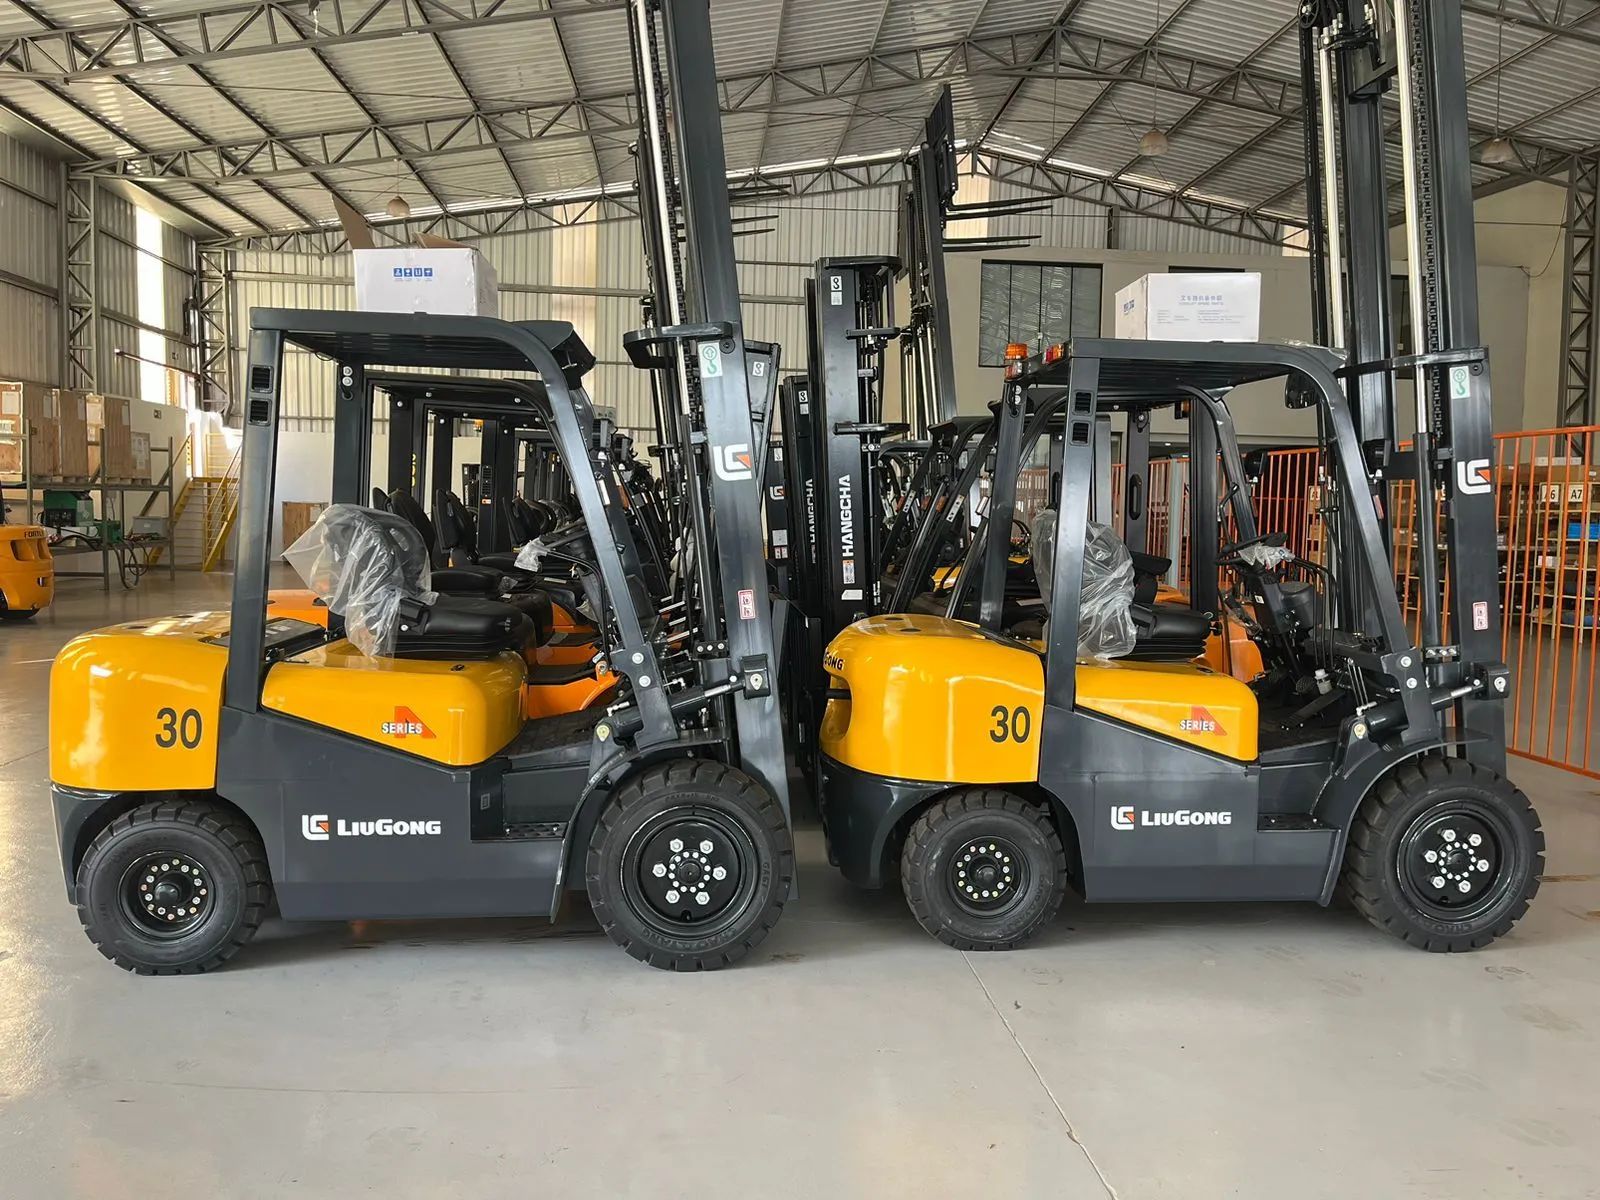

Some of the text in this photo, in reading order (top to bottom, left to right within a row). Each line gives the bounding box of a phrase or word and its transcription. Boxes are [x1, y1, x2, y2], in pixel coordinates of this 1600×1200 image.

[1570, 488, 1583, 500] A7
[838, 474, 855, 557] HANGCHA
[155, 707, 202, 749] 30
[381, 722, 423, 735] SERIES
[989, 705, 1031, 744] 30
[1179, 719, 1216, 731] SERIES
